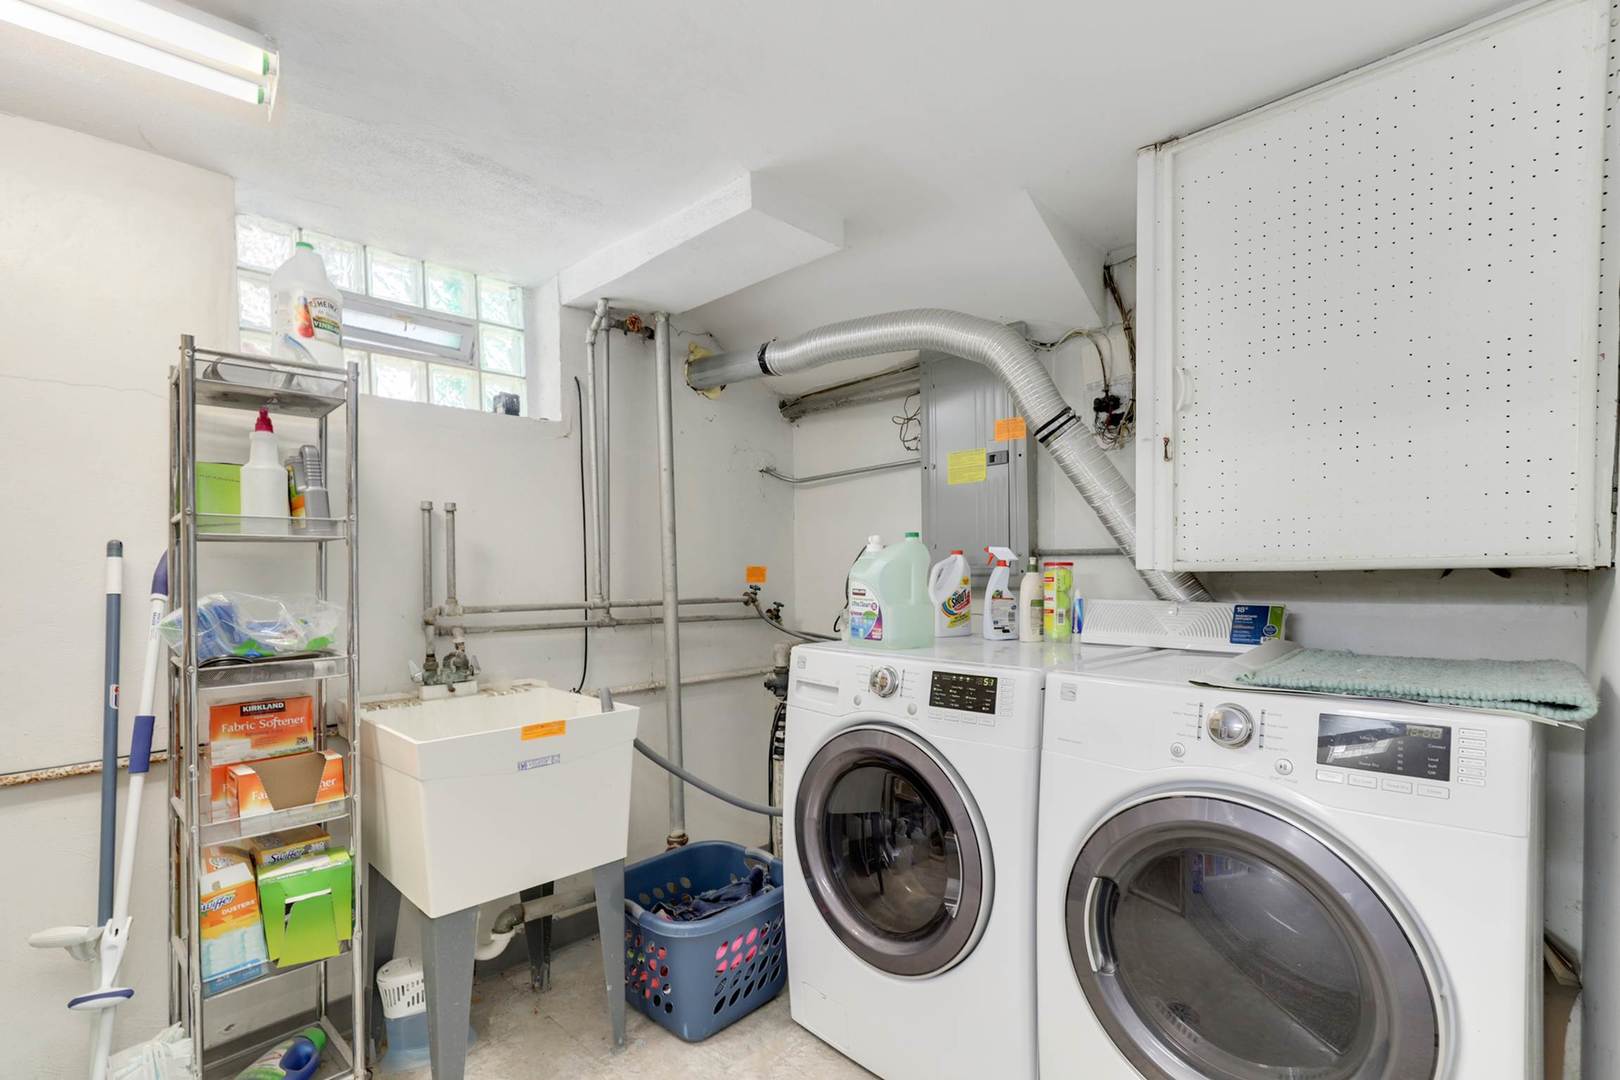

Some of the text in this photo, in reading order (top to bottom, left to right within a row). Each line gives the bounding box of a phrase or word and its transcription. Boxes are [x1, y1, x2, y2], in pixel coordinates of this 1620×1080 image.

[242, 702, 284, 713] KIRKLAND
[221, 715, 305, 733] Fabric Softener
[201, 895, 234, 911] wiffer
[221, 899, 257, 915] DUSTERS
